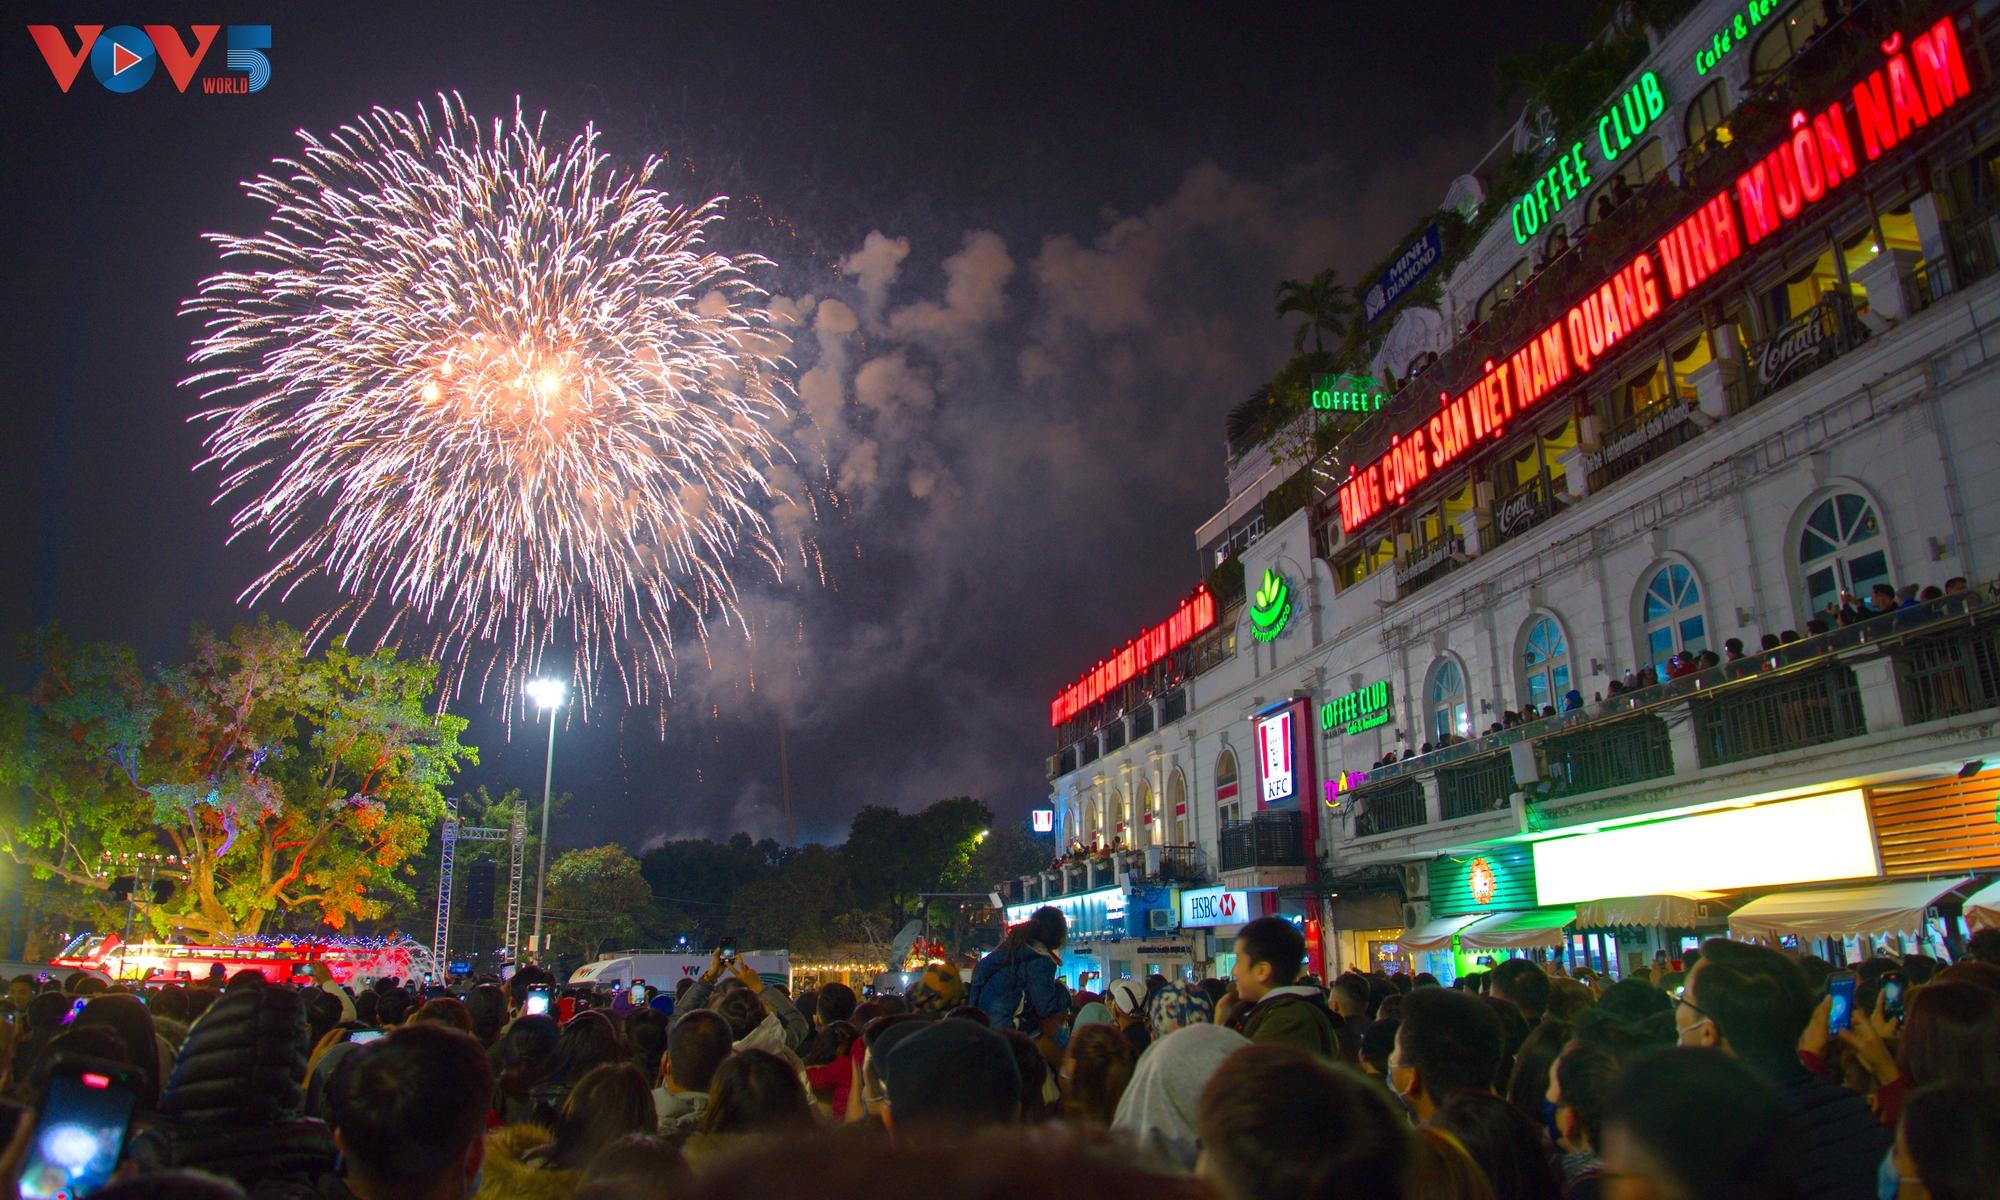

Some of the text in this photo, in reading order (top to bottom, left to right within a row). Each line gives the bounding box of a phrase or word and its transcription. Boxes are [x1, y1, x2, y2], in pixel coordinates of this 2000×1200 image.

[1696, 28, 1731, 75] Café
[1733, 14, 1747, 39] &
[1512, 71, 1665, 245] COFFEE CLUB
[1381, 429, 1428, 505] CỘNG
[1429, 391, 1470, 469] SẢN
[1467, 359, 1512, 439] VIỆT
[1512, 321, 1569, 409] NAM
[1568, 253, 1660, 372] QUANG
[1658, 190, 1741, 299] VINH
[1736, 102, 1856, 245] MUÔN
[1852, 16, 1971, 161] NĂM
[1387, 247, 1436, 301] DIAMOND
[1390, 235, 1428, 282] MINH
[1312, 390, 1369, 412] COFFEE
[1251, 603, 1291, 642] PHYTOPHARCO
[1321, 680, 1388, 730] COFFEE CLUB
[1269, 778, 1287, 798] KFC
[1191, 895, 1217, 919] HSBC
[682, 965, 700, 976] VTV
